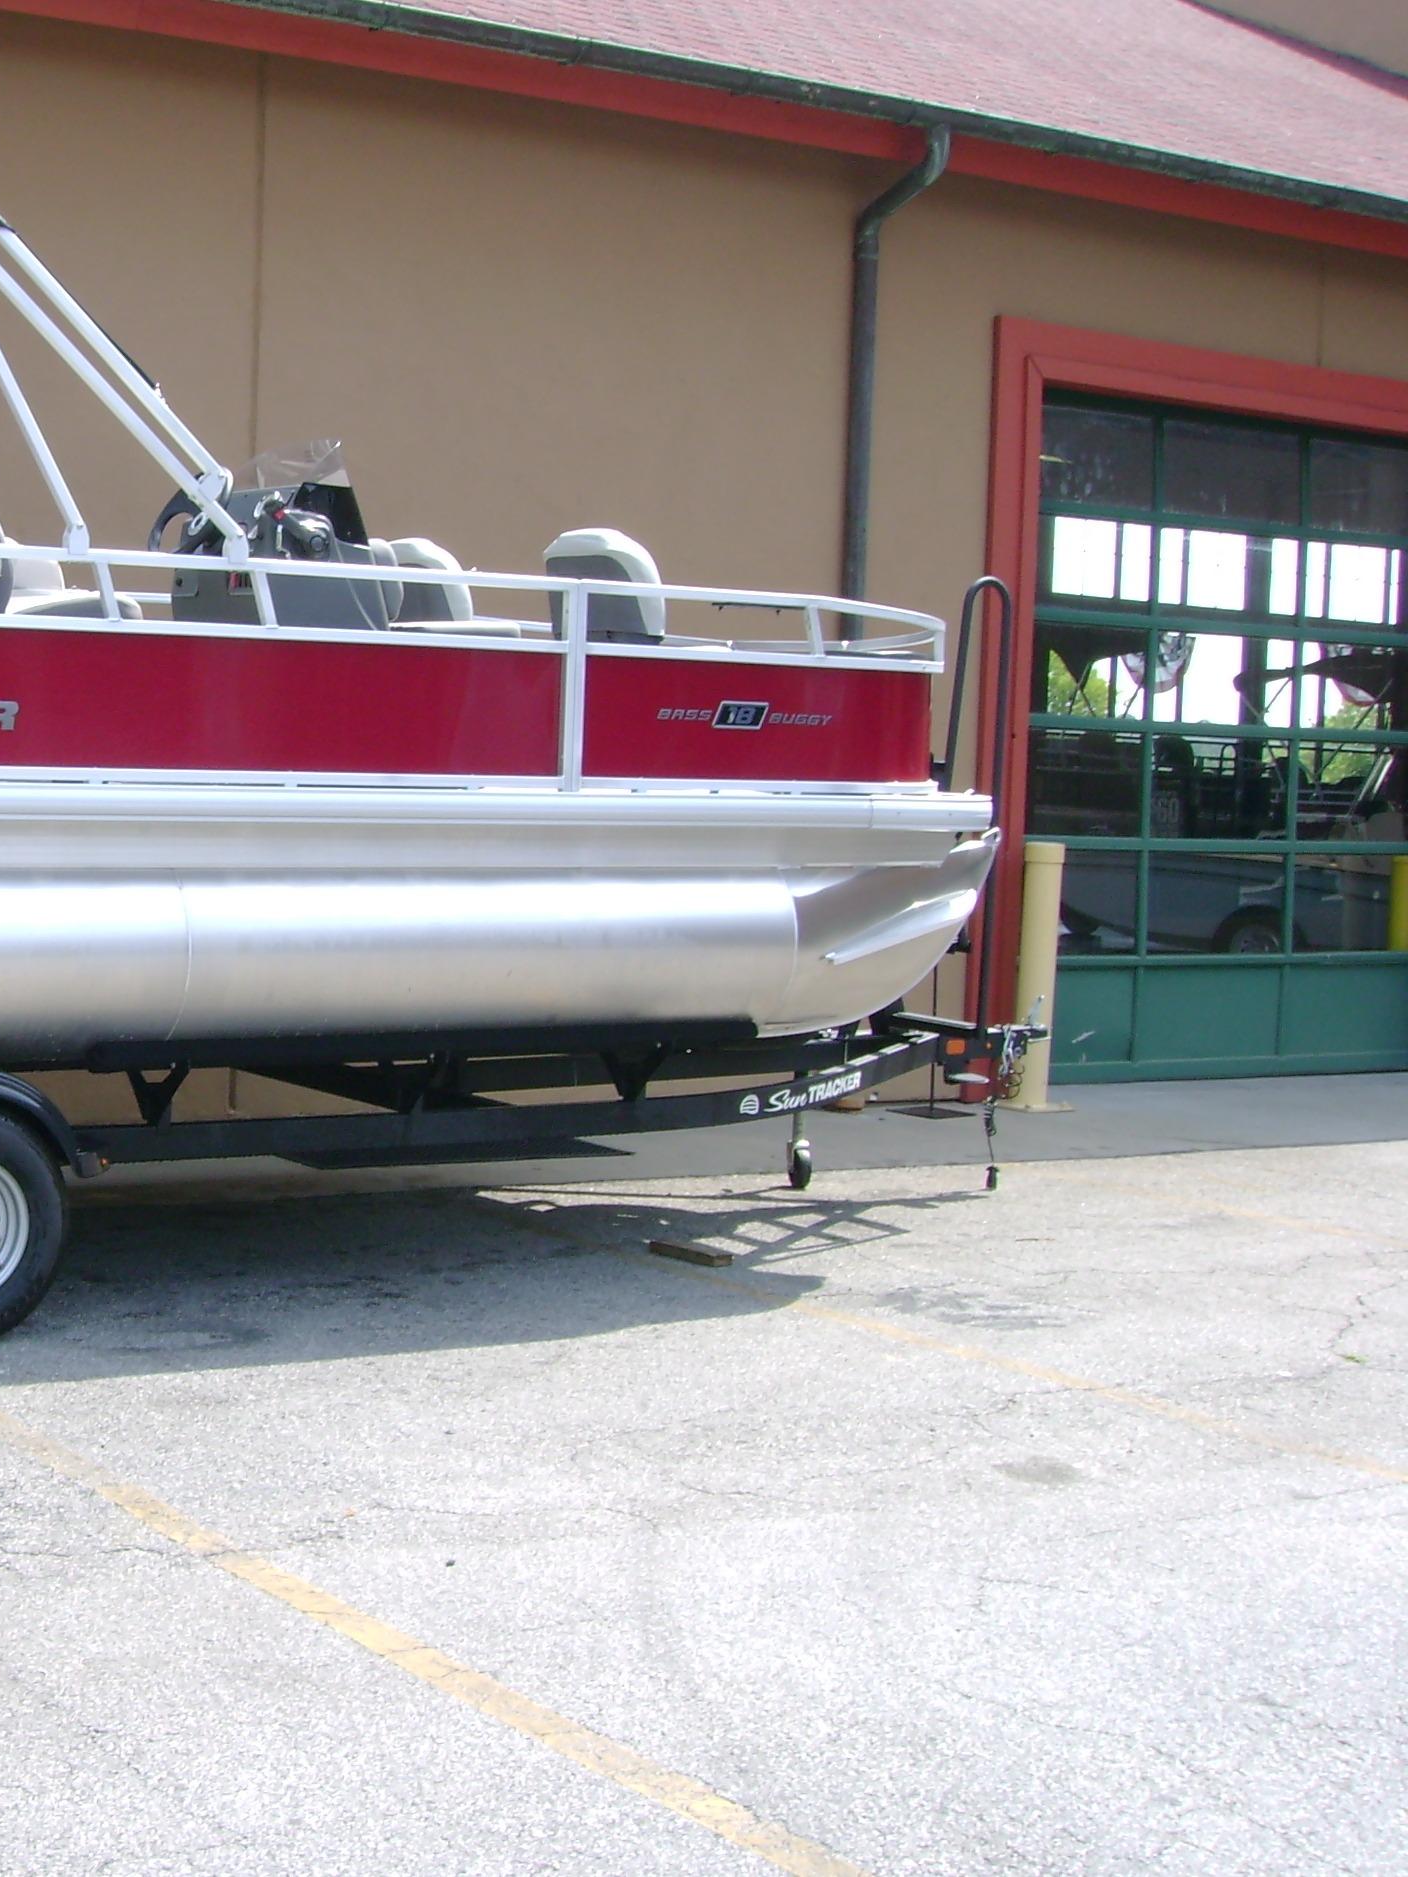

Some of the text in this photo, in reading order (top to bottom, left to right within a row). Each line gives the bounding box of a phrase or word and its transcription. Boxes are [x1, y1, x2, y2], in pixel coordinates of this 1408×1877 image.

[657, 706, 833, 726] BASS 18 BUGGY
[763, 1070, 863, 1113] Sun TRACKER
